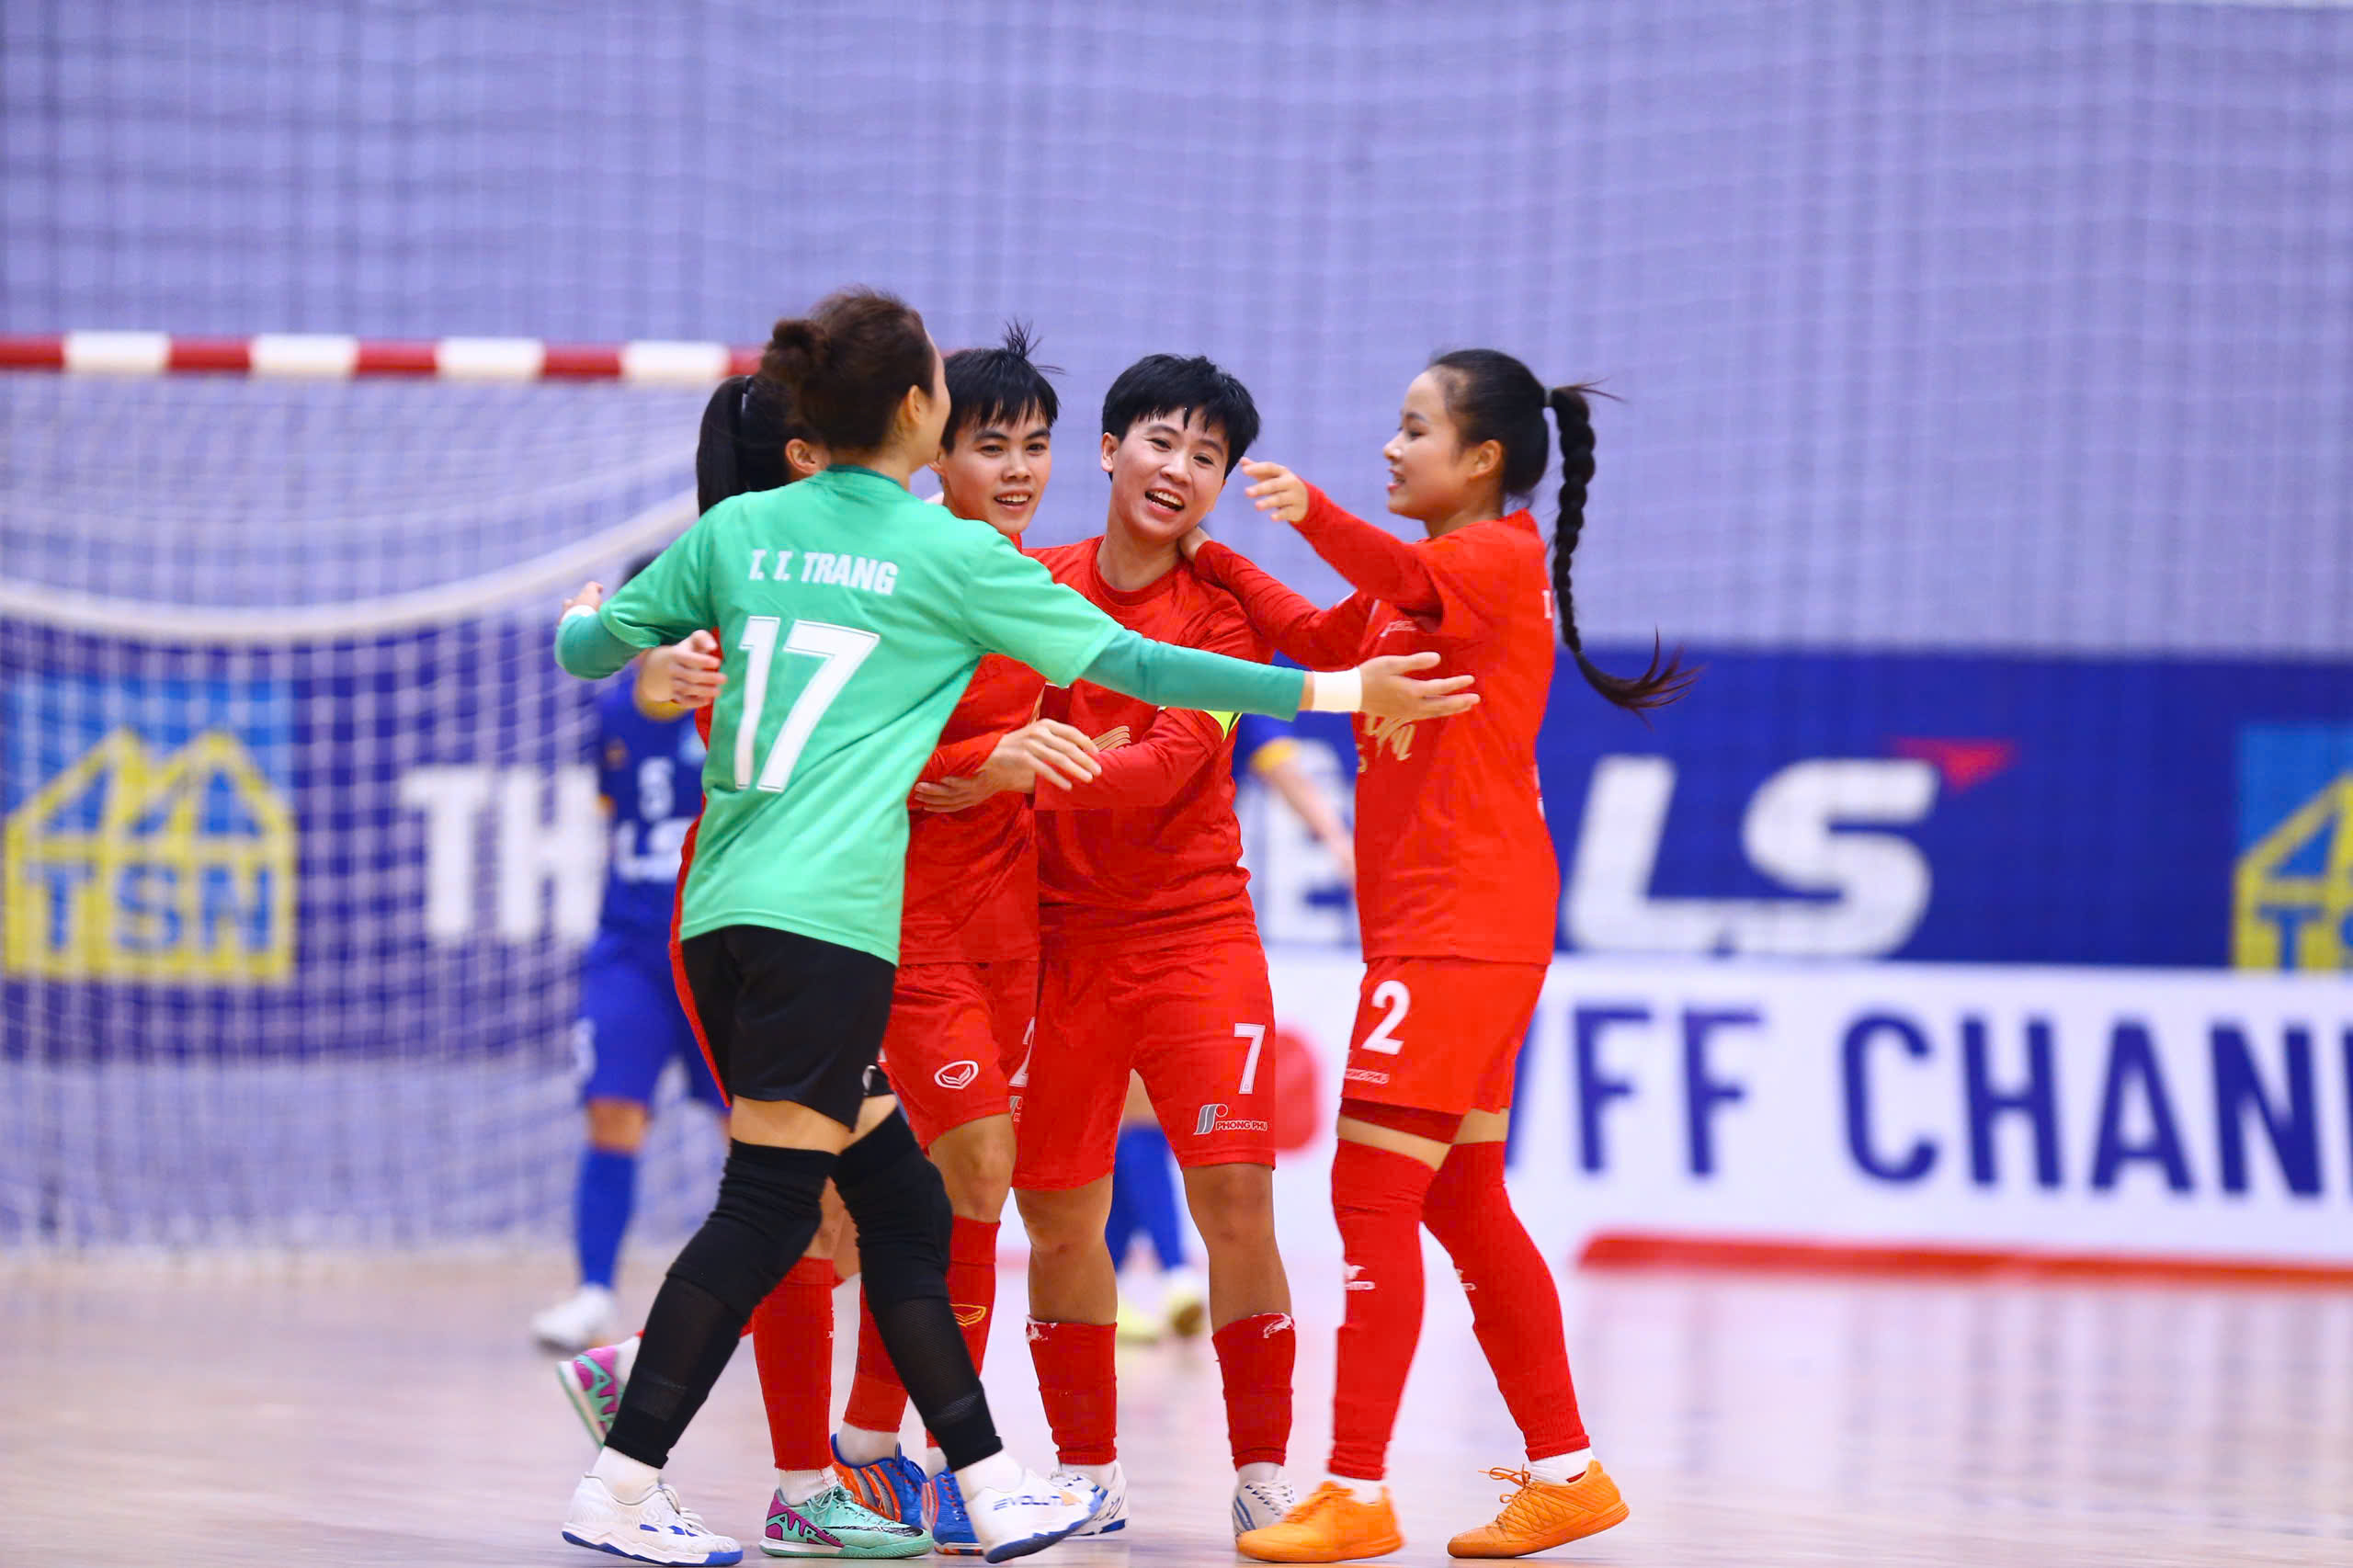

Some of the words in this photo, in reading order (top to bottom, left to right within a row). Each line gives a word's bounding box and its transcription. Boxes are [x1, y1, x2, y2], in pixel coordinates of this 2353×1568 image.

[801, 551, 898, 597] TRANG
[734, 615, 881, 792] 17
[1564, 753, 1943, 956] LS
[23, 862, 273, 954] TSN
[1233, 1023, 1266, 1095] 7
[1362, 980, 1410, 1055] 2
[1216, 1120, 1251, 1131] PHONG
[1843, 1012, 2353, 1198] CHAN
